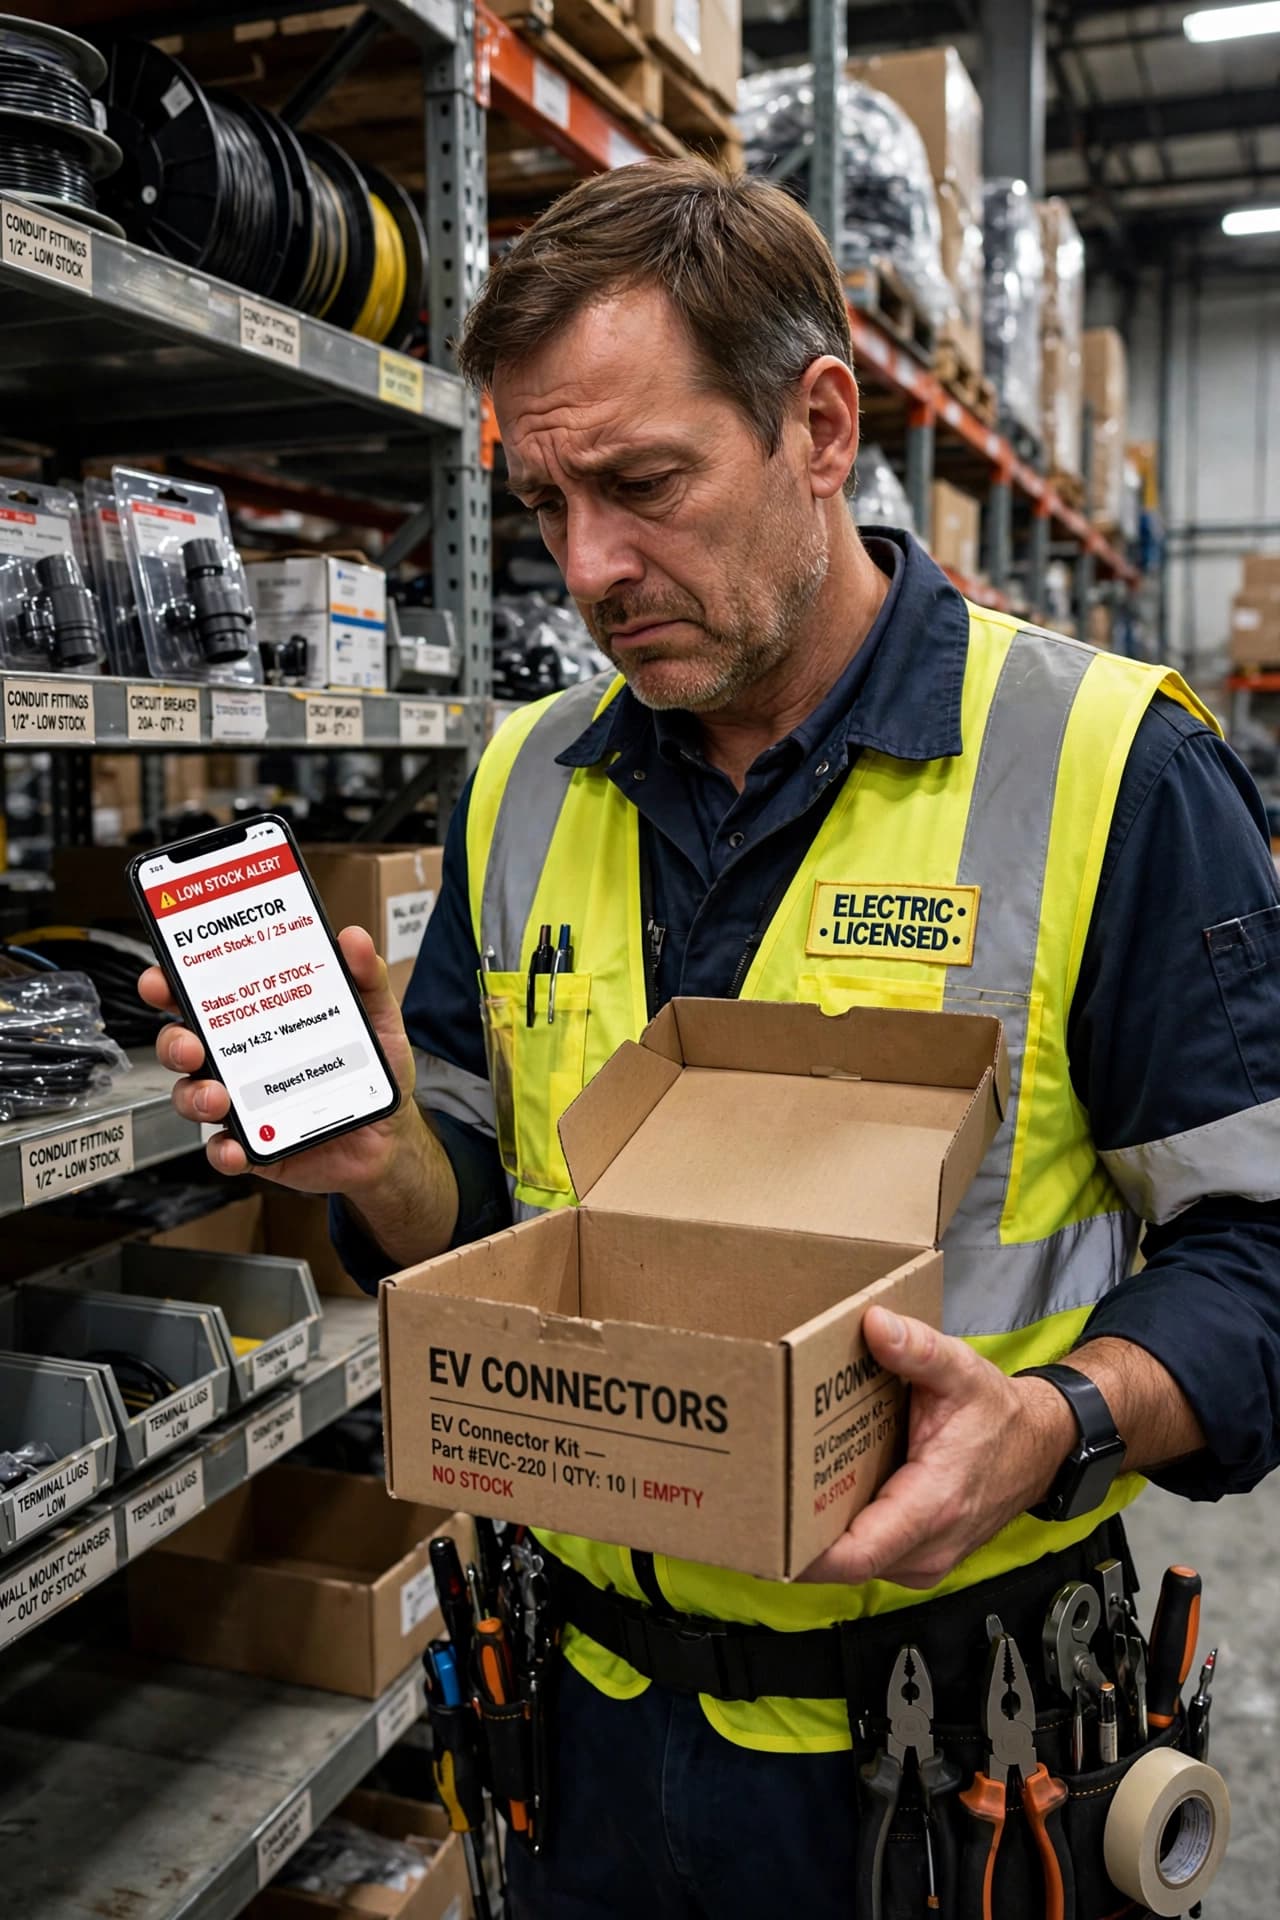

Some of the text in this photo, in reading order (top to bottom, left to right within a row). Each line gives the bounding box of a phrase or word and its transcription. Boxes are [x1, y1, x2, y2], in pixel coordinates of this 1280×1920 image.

[6, 213, 86, 258] CONDUIT FITTINGS
[9, 238, 27, 256] 1/2"
[34, 246, 54, 267] LOW
[55, 254, 84, 278] STOCK
[8, 691, 89, 710] CONDUIT FITTINGS
[12, 714, 29, 731] 1/2"
[37, 715, 57, 731] LOW
[58, 716, 86, 731] STOCK
[130, 695, 162, 711] CIRCUIT
[163, 697, 197, 713] BREAKER
[138, 716, 153, 730] 20A
[179, 718, 185, 732] 2
[175, 855, 282, 902] LOW STOCK ALERT
[173, 898, 287, 948] EV CONNECTOR
[833, 894, 954, 924] ELECTRIC
[182, 945, 222, 968] Current
[223, 934, 256, 954] Stock:
[257, 930, 265, 942] 0
[272, 923, 287, 937] 25
[288, 915, 315, 931] units
[833, 921, 949, 951] LICENSED
[201, 993, 238, 1013] Status:
[238, 982, 262, 999] OUT
[262, 975, 277, 991] OF
[278, 963, 314, 985] STOCK
[208, 984, 313, 1030] RESTOCK REQUIRED
[219, 1040, 248, 1059] Today
[247, 1030, 274, 1047] 14:32
[278, 1012, 328, 1037] Warehouse
[328, 1005, 341, 1018] #4
[264, 1056, 346, 1096] Request Restock
[29, 1125, 125, 1168] CONDUIT FITTINGS
[35, 1168, 56, 1190] 1/2"
[65, 1159, 88, 1180] LOW
[89, 1148, 121, 1172] STOCK
[149, 1387, 209, 1433] TERMINAL LUGS
[429, 1347, 472, 1388] EV
[481, 1356, 729, 1434] CONNECTORS
[815, 1376, 833, 1418] EV
[171, 1416, 190, 1440] LOW
[431, 1413, 453, 1434] EV
[458, 1418, 549, 1453] Connector
[555, 1436, 580, 1458] Kit
[815, 1439, 828, 1465] EV
[829, 1411, 872, 1454] Connector
[872, 1400, 885, 1422] Kit
[432, 1438, 464, 1461] Part
[468, 1446, 547, 1478] #EVC-220
[563, 1464, 600, 1490] QTY:
[607, 1474, 626, 1494] 10
[643, 1479, 704, 1509] EMPTY
[432, 1464, 514, 1499] NO STOCK
[814, 1463, 833, 1490] Part
[833, 1431, 872, 1475] #EVC-220
[17, 1461, 89, 1513] TERMINAL LUGS
[47, 1494, 67, 1518] LOW
[131, 1470, 198, 1524] TERMINAL LUGS
[814, 1469, 857, 1518] NO STOCK
[158, 1503, 178, 1526] LOW
[0, 1527, 111, 1611] WALL MOUNT CHARGER
[17, 1596, 39, 1621] OUT
[41, 1586, 54, 1605] OF
[56, 1563, 88, 1596] STOCK
